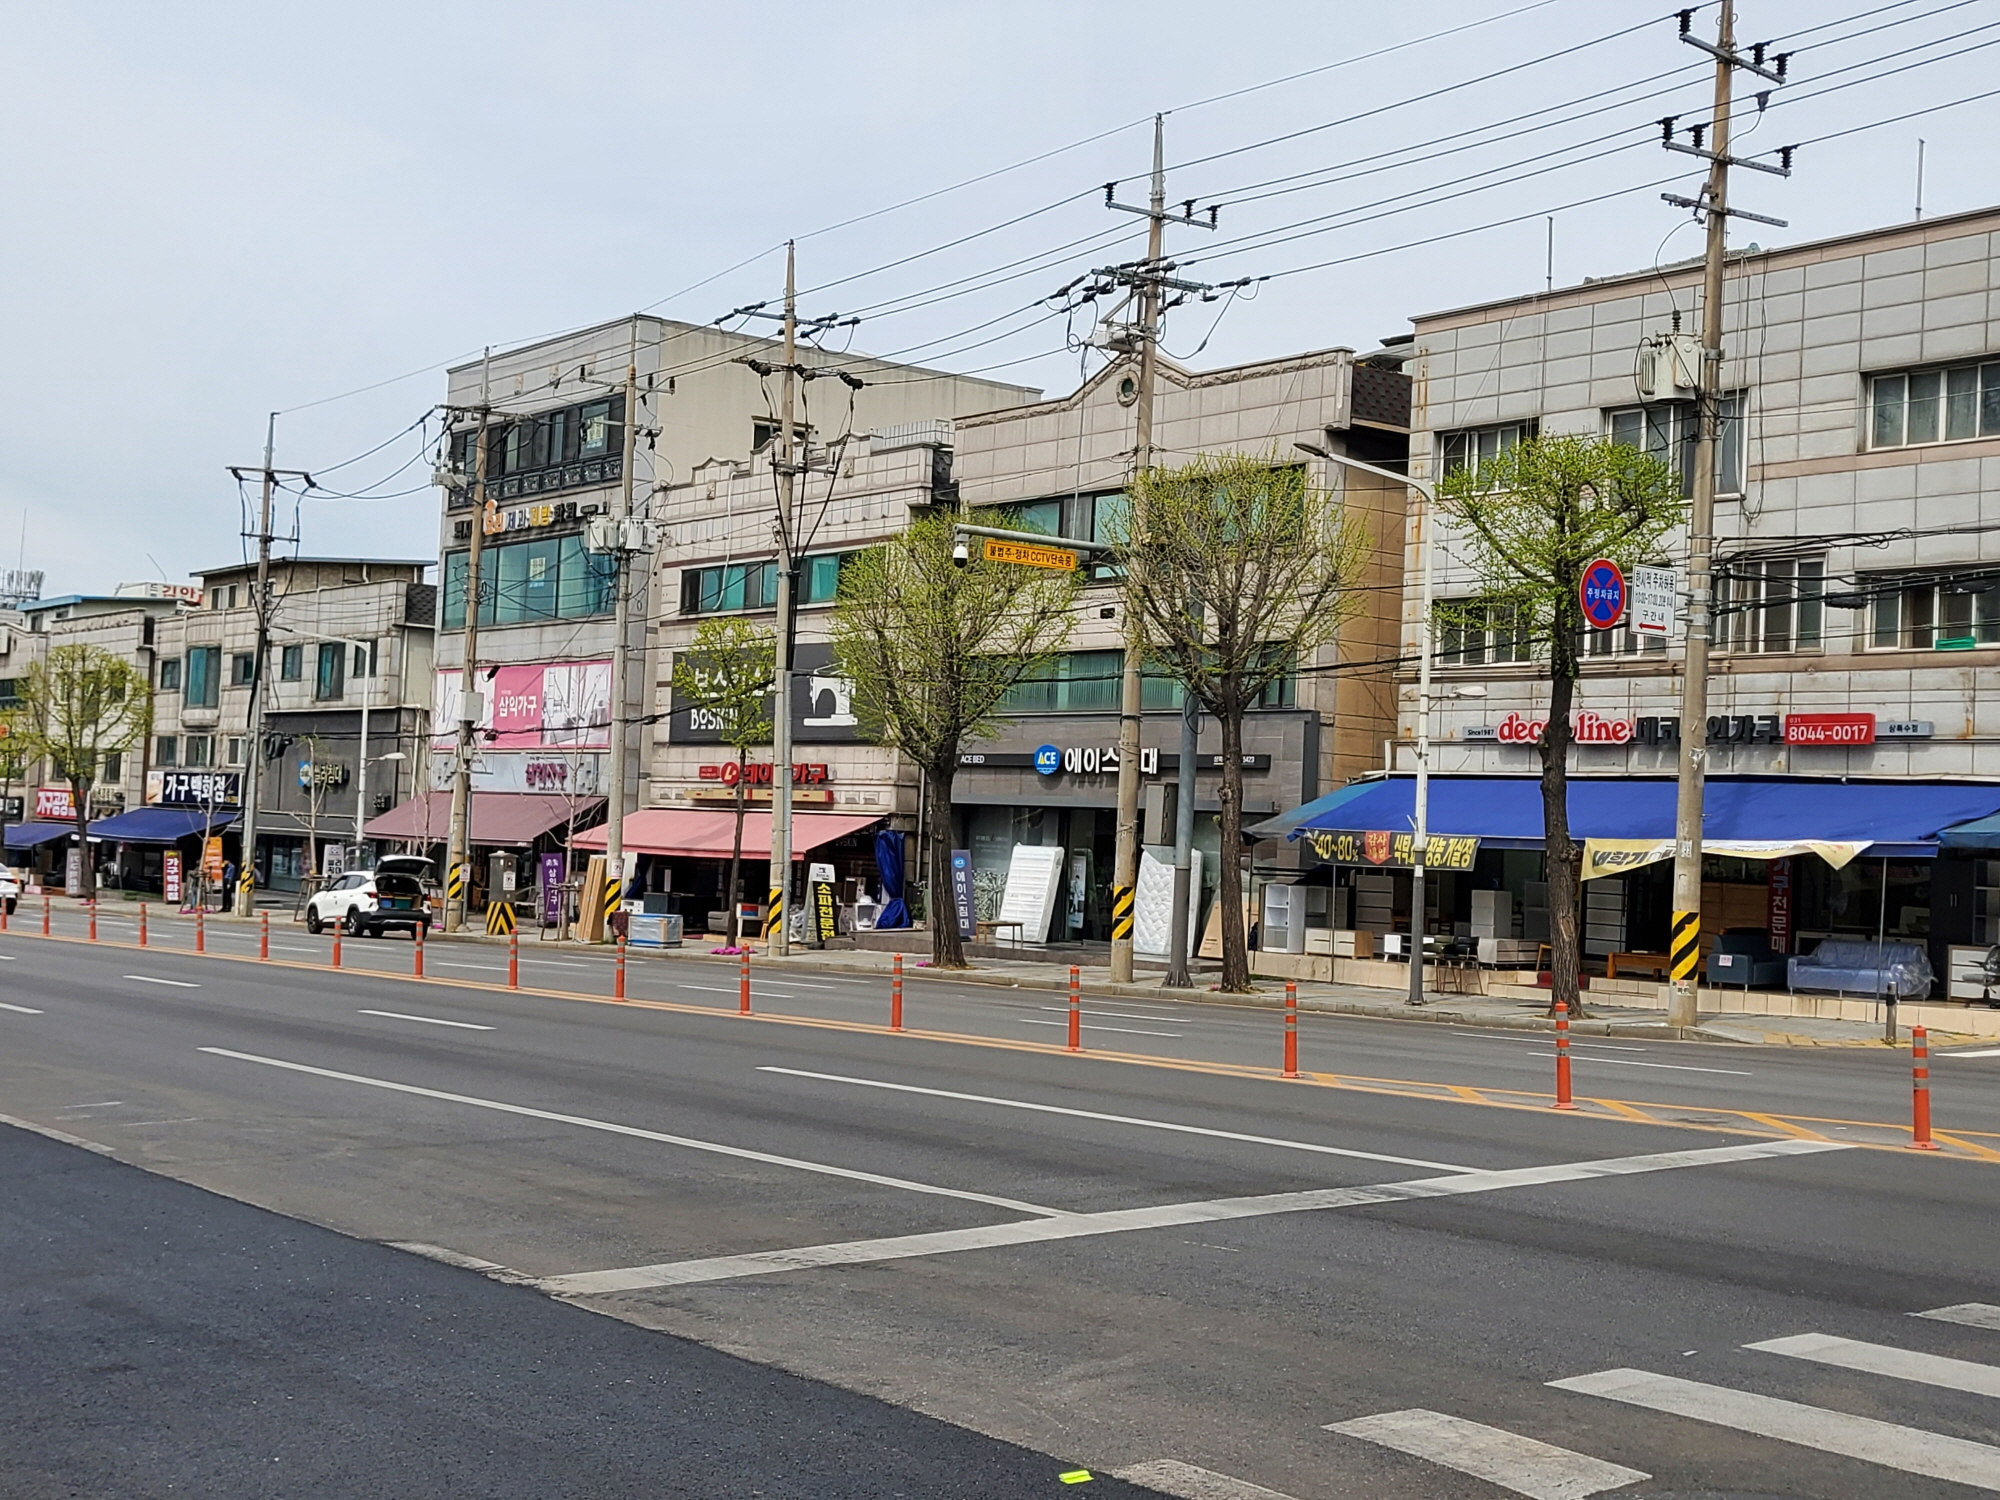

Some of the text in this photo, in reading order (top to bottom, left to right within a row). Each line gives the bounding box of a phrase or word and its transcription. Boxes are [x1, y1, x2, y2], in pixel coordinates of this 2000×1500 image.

[1587, 587, 1619, 600] 주정차금지
[499, 695, 537, 718] 삼익가구
[1636, 715, 1780, 745] 데코인가구
[1788, 725, 1868, 741] 8044-0017
[1037, 752, 1056, 765] ACE
[1064, 747, 1159, 774] 에이스대
[165, 774, 226, 803] 가구백화점
[817, 882, 836, 941] 소파전문점
[956, 871, 970, 930] 에이스침대
